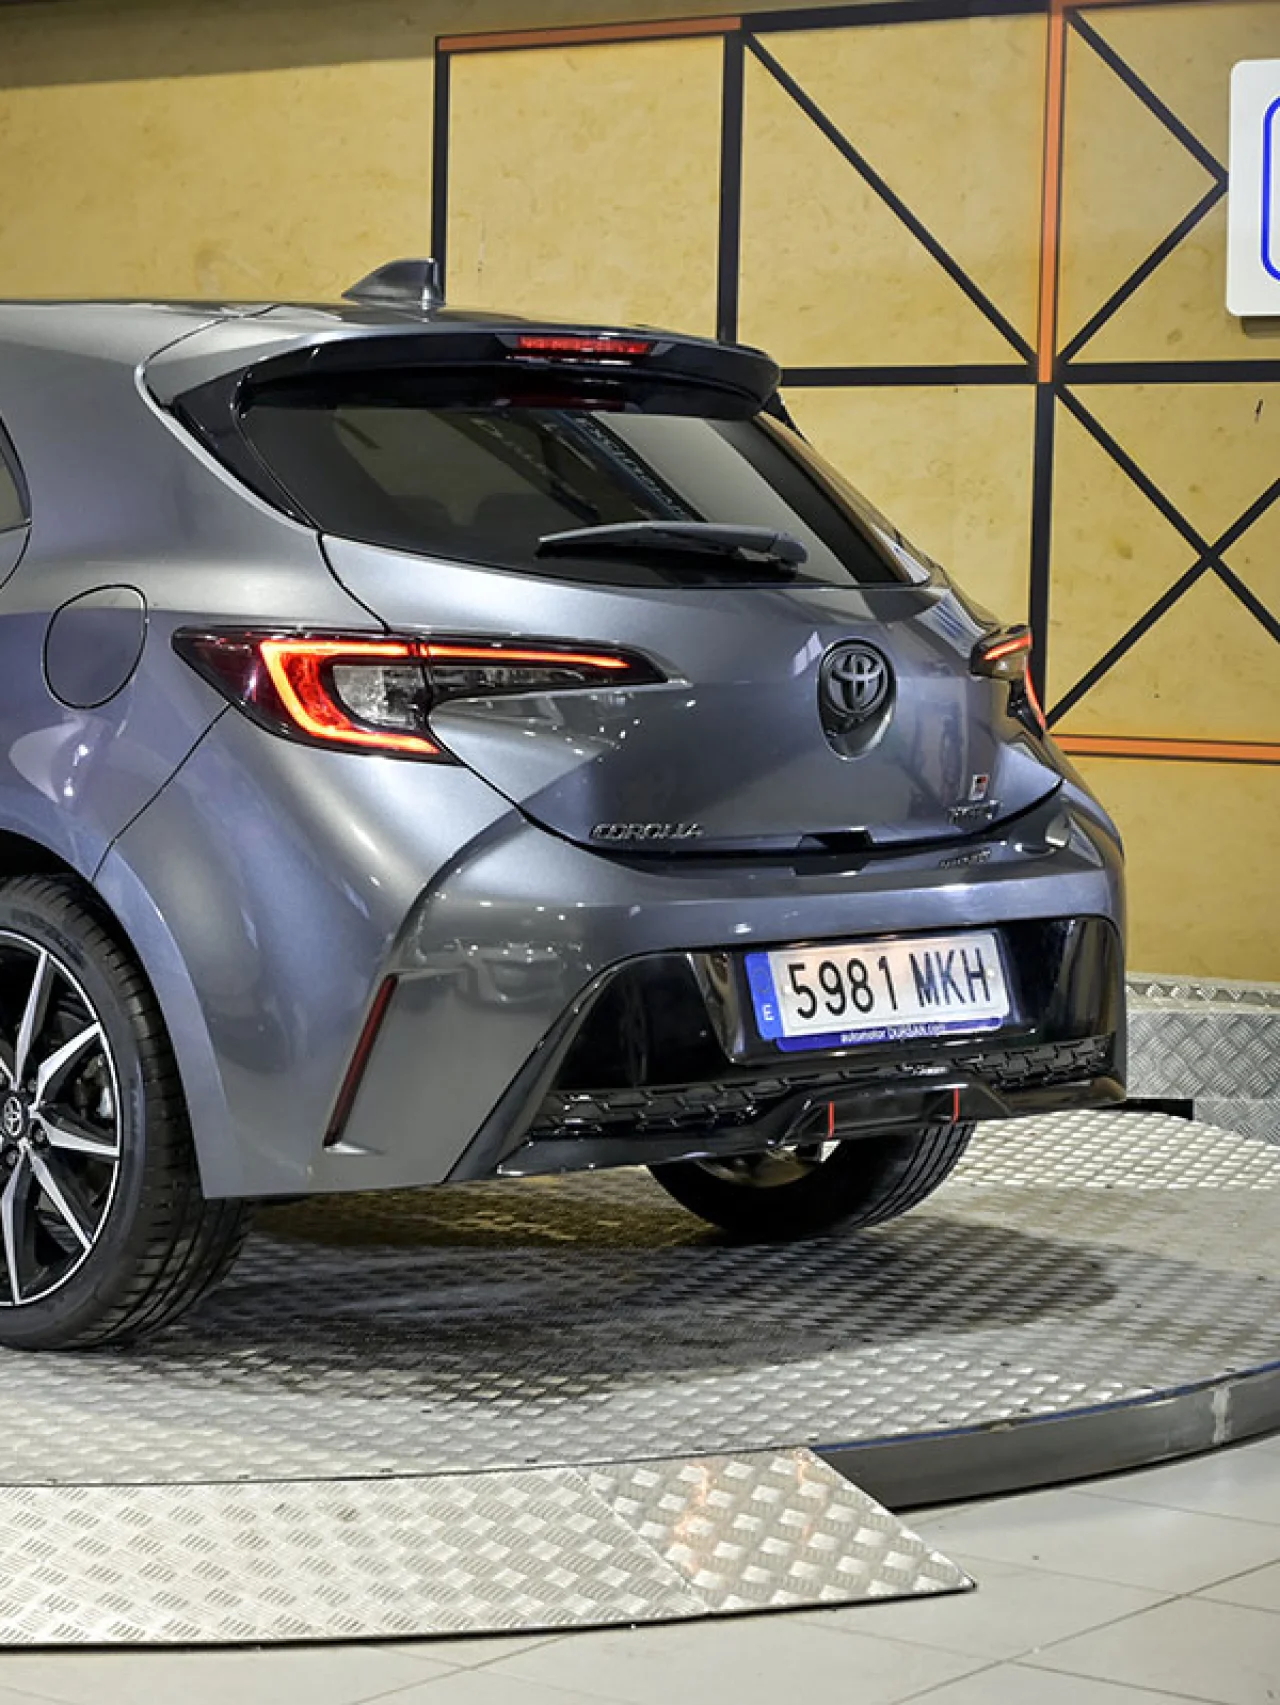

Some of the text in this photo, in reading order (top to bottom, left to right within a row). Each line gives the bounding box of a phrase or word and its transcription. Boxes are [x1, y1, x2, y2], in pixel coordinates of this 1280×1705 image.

[590, 822, 703, 840] COROLLA
[787, 946, 991, 1019] 5981 MKH
[761, 1003, 775, 1021] E
